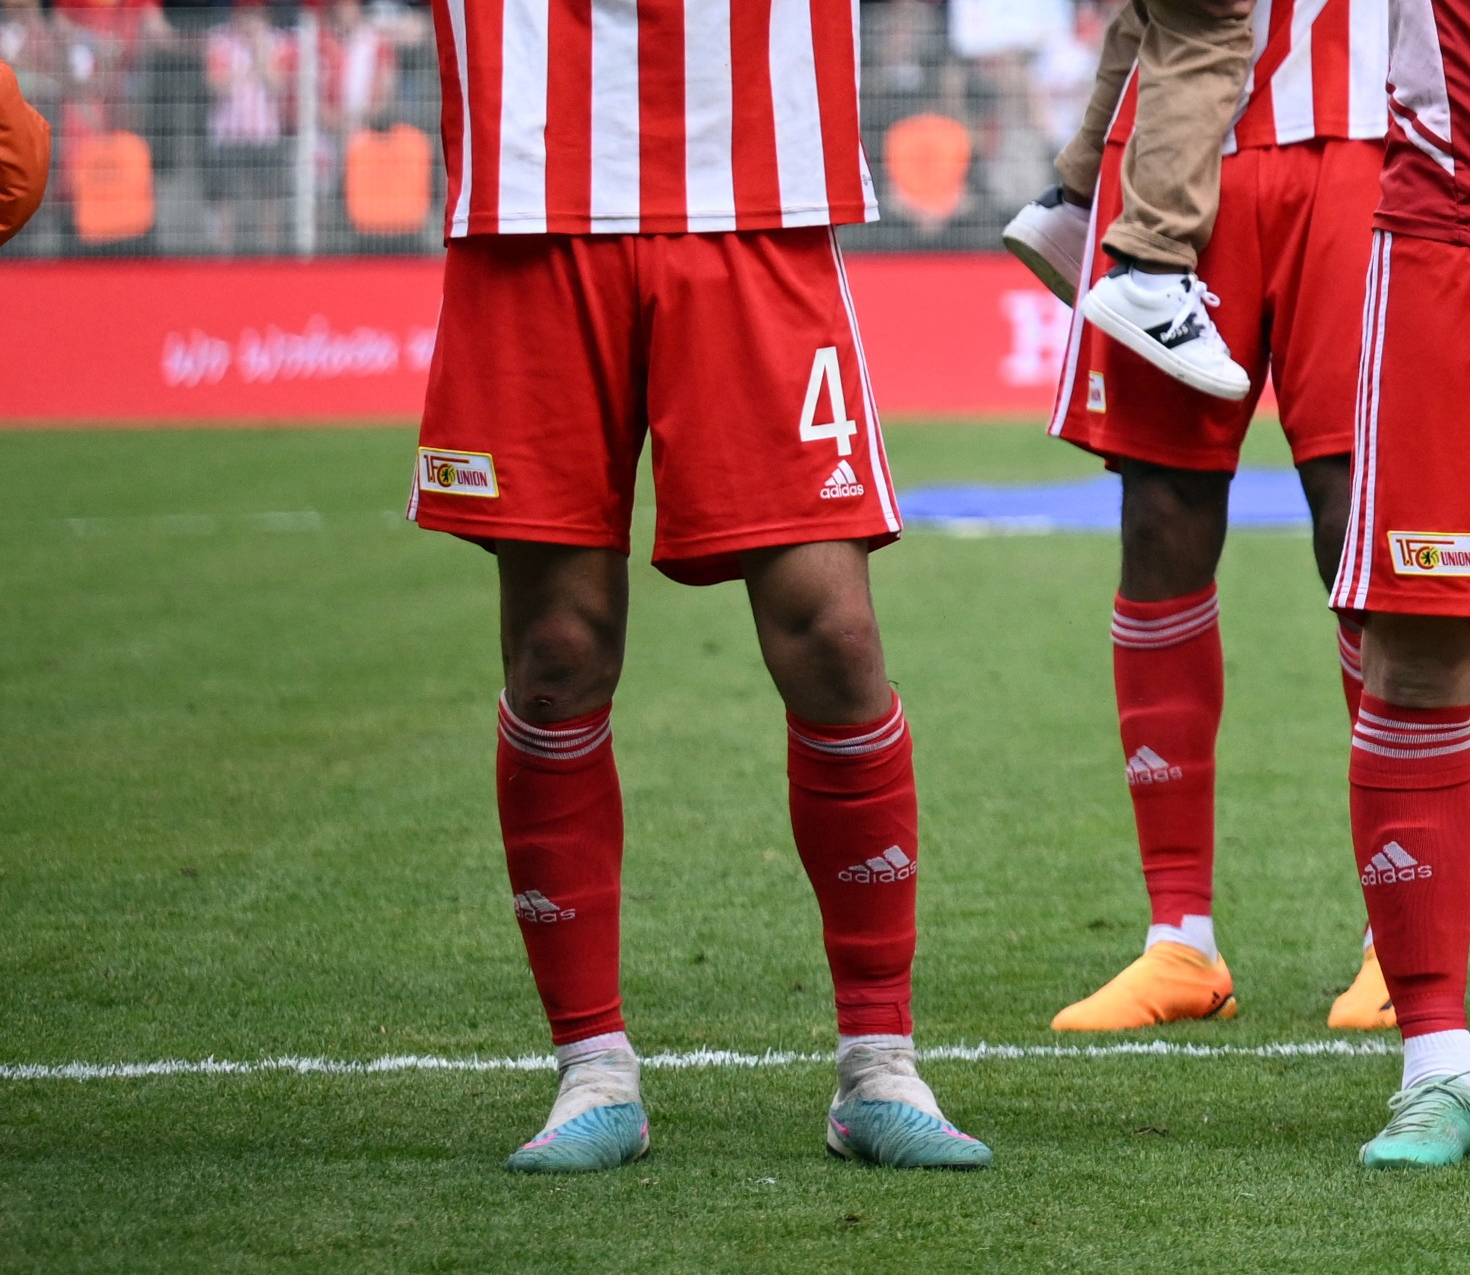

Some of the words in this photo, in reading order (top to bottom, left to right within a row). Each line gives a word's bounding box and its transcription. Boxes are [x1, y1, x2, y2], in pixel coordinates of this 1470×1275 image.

[799, 346, 858, 456] 4
[457, 466, 488, 485] UNION
[819, 483, 864, 498] adidas
[838, 862, 917, 883] adidas
[1361, 864, 1433, 886] adidas
